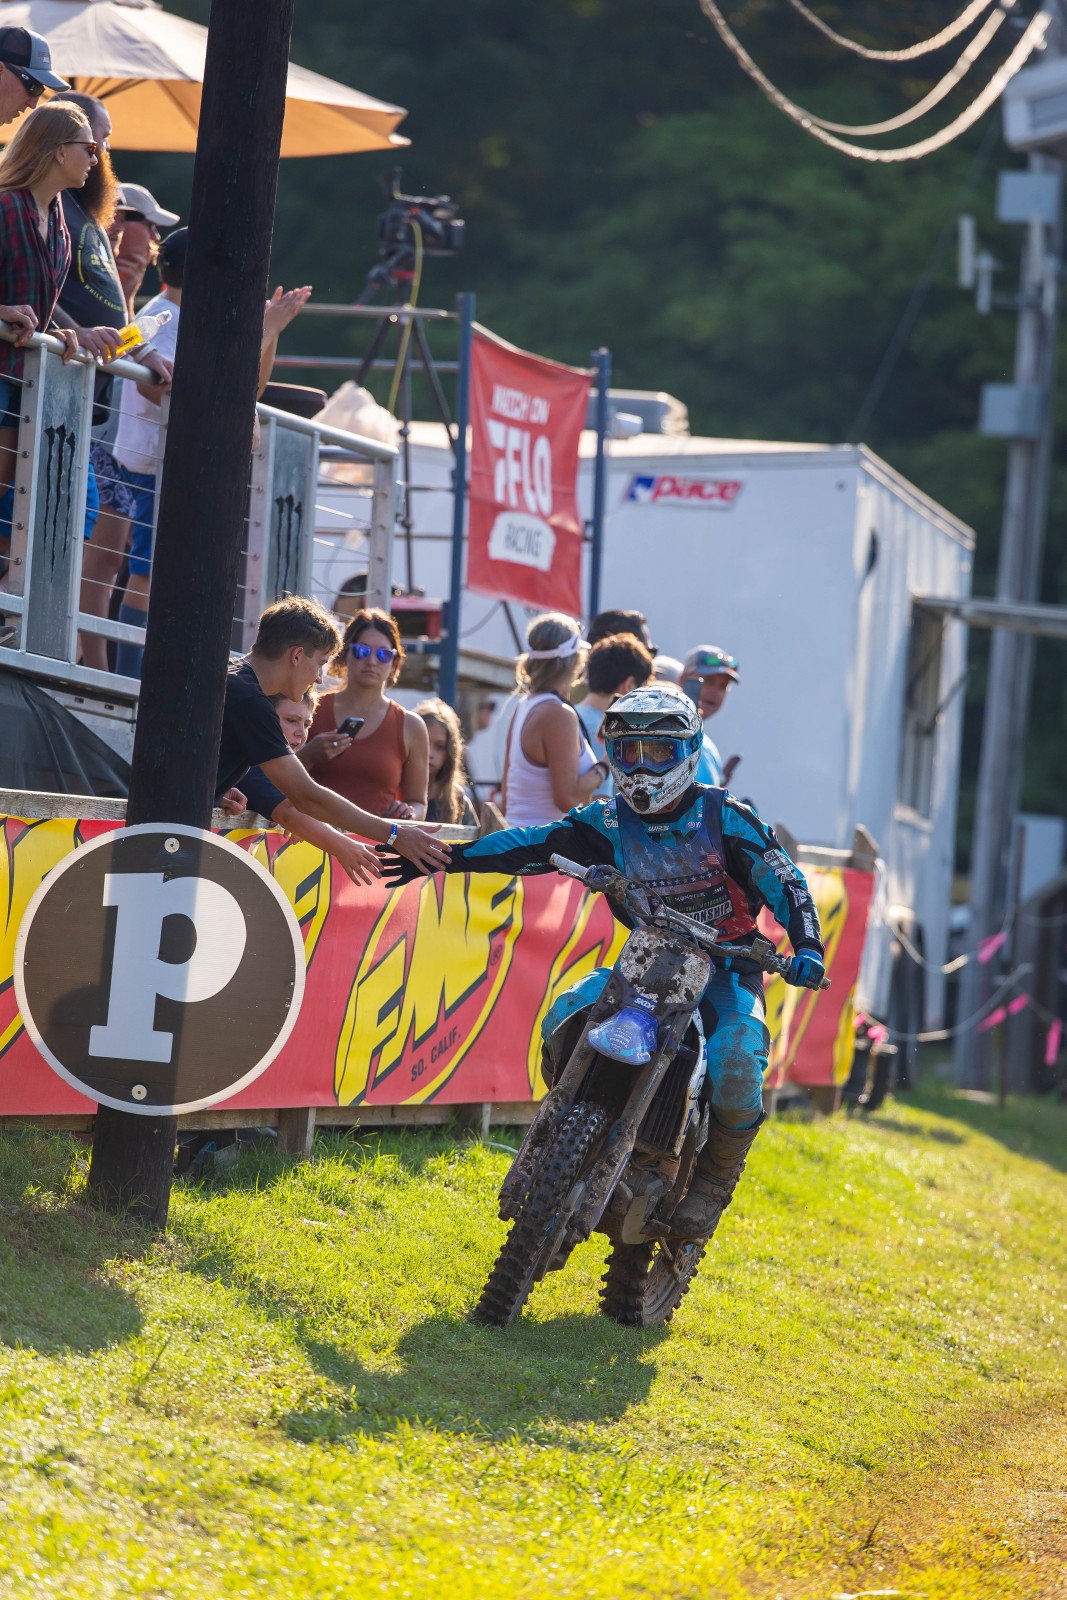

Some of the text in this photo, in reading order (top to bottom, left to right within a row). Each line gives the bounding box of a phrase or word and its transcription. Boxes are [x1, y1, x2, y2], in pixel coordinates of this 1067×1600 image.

[492, 384, 551, 425] WATCH ON
[504, 521, 543, 558] RACING
[686, 903, 731, 923] IONSHIP
[338, 872, 517, 1106] FMF
[411, 1025, 461, 1082] SO. CALIF.
